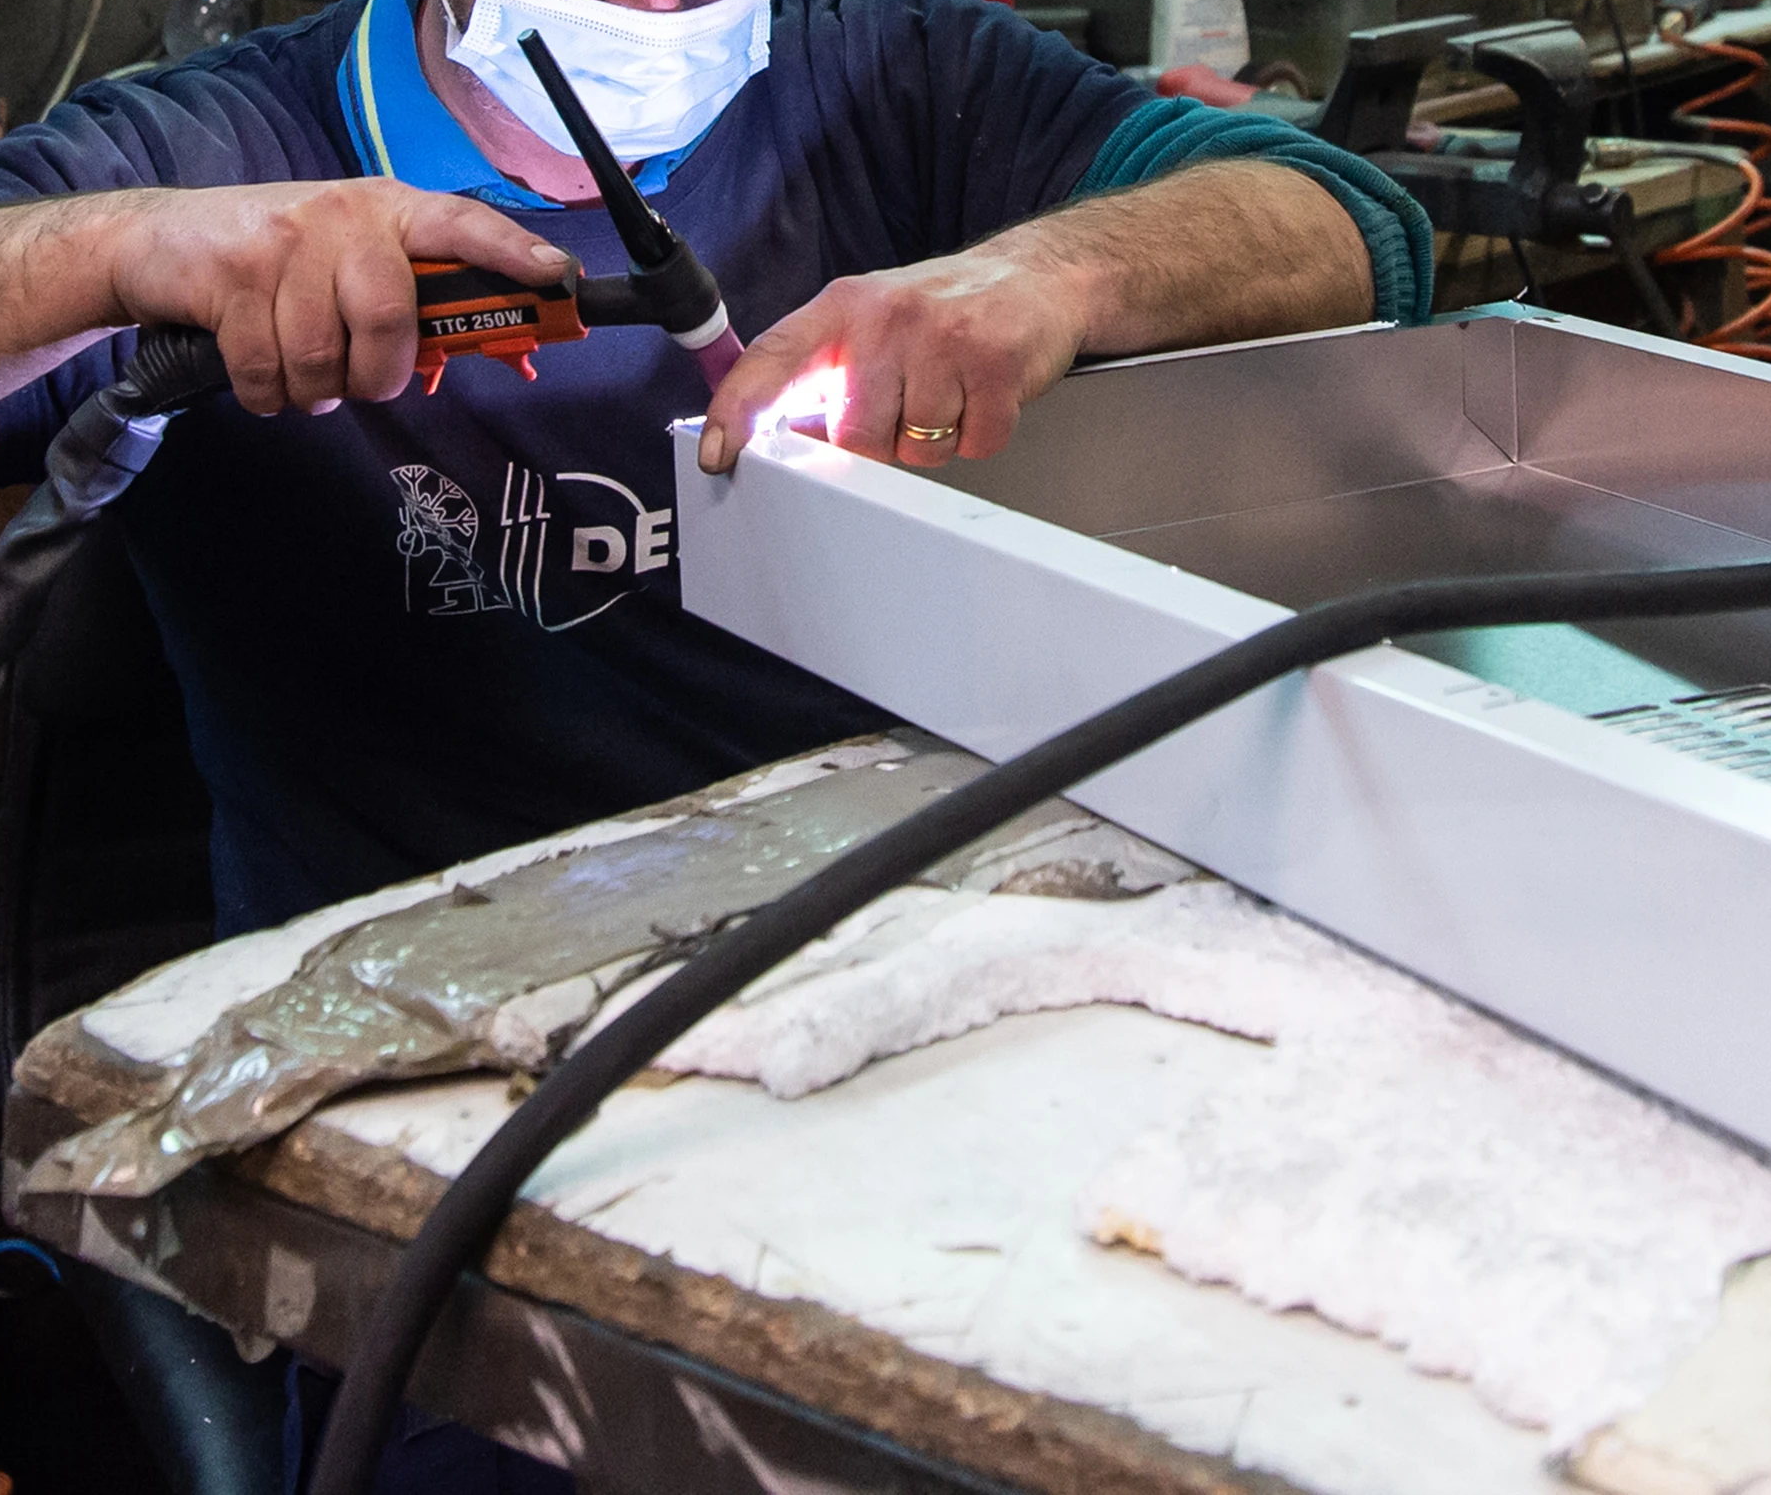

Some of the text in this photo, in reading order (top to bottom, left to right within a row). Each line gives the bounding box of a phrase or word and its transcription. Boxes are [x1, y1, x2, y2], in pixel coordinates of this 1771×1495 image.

[431, 309, 524, 336] TTC 250W
[571, 507, 674, 575] DE
